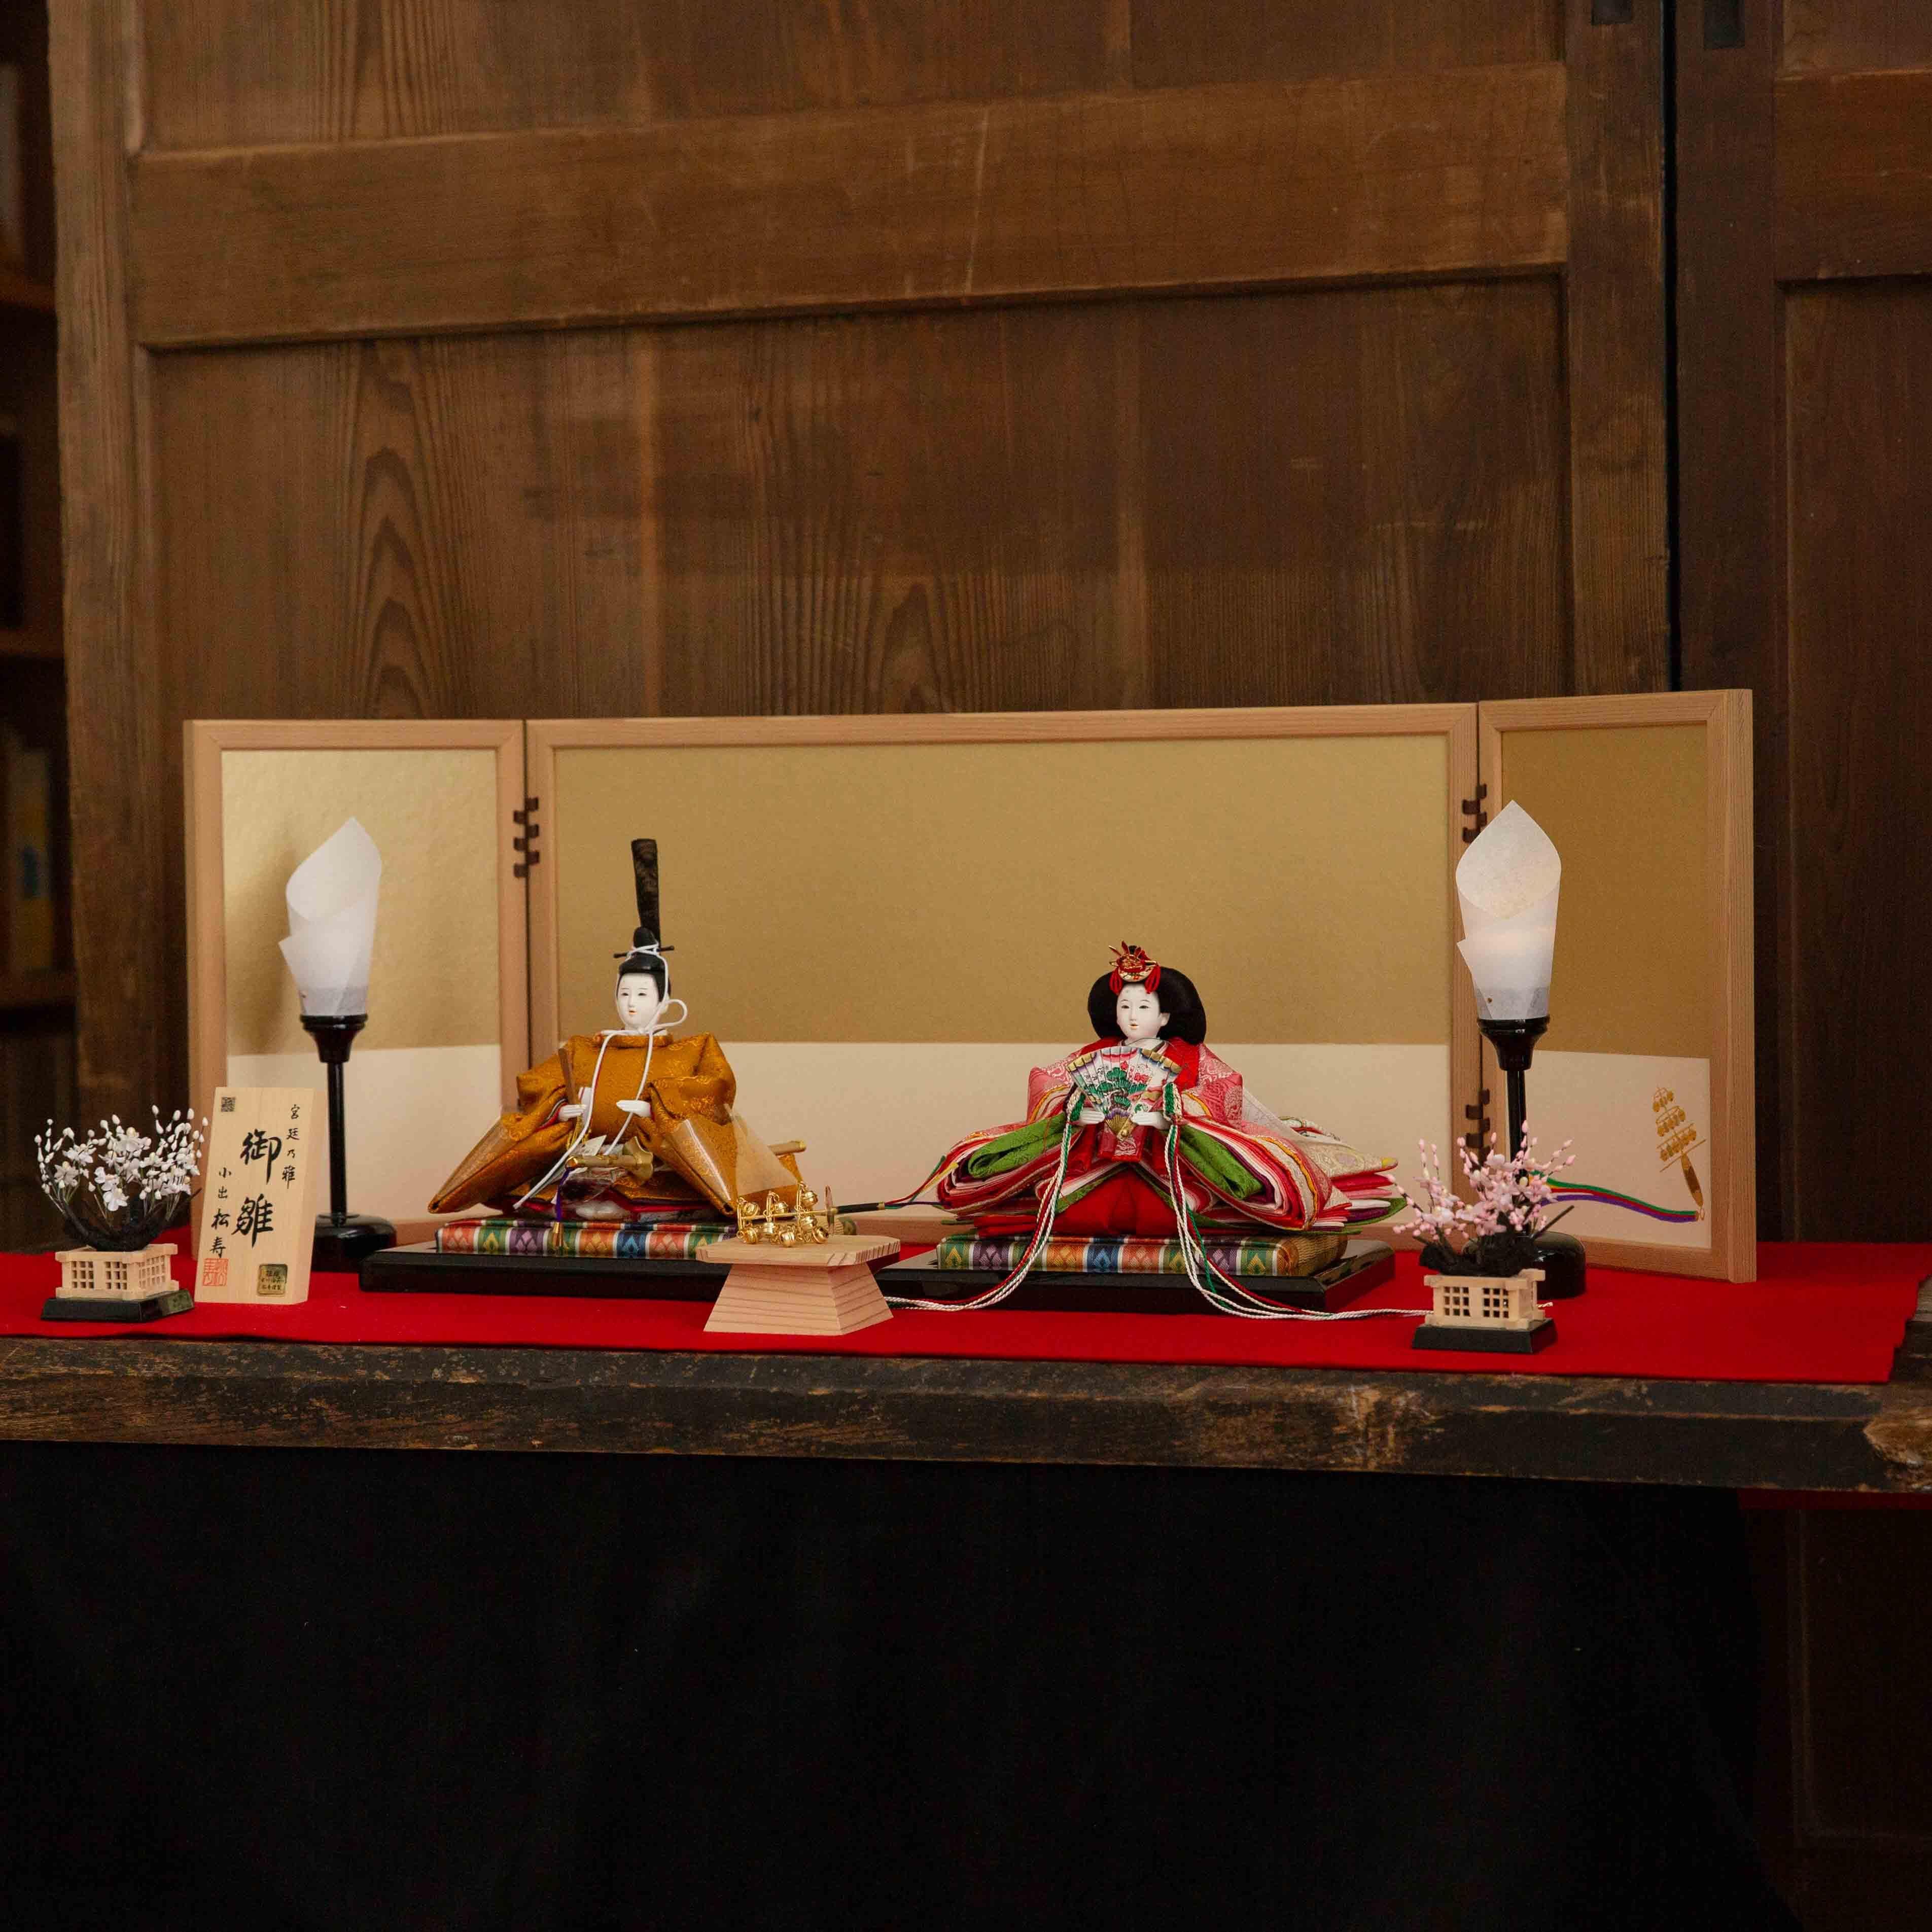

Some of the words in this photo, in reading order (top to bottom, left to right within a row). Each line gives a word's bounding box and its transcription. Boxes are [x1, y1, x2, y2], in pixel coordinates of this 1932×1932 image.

[231, 1129, 282, 1248] 御雛
[282, 1104, 300, 1189] 宮廷乃雅
[209, 1167, 232, 1258] 小出松寿
